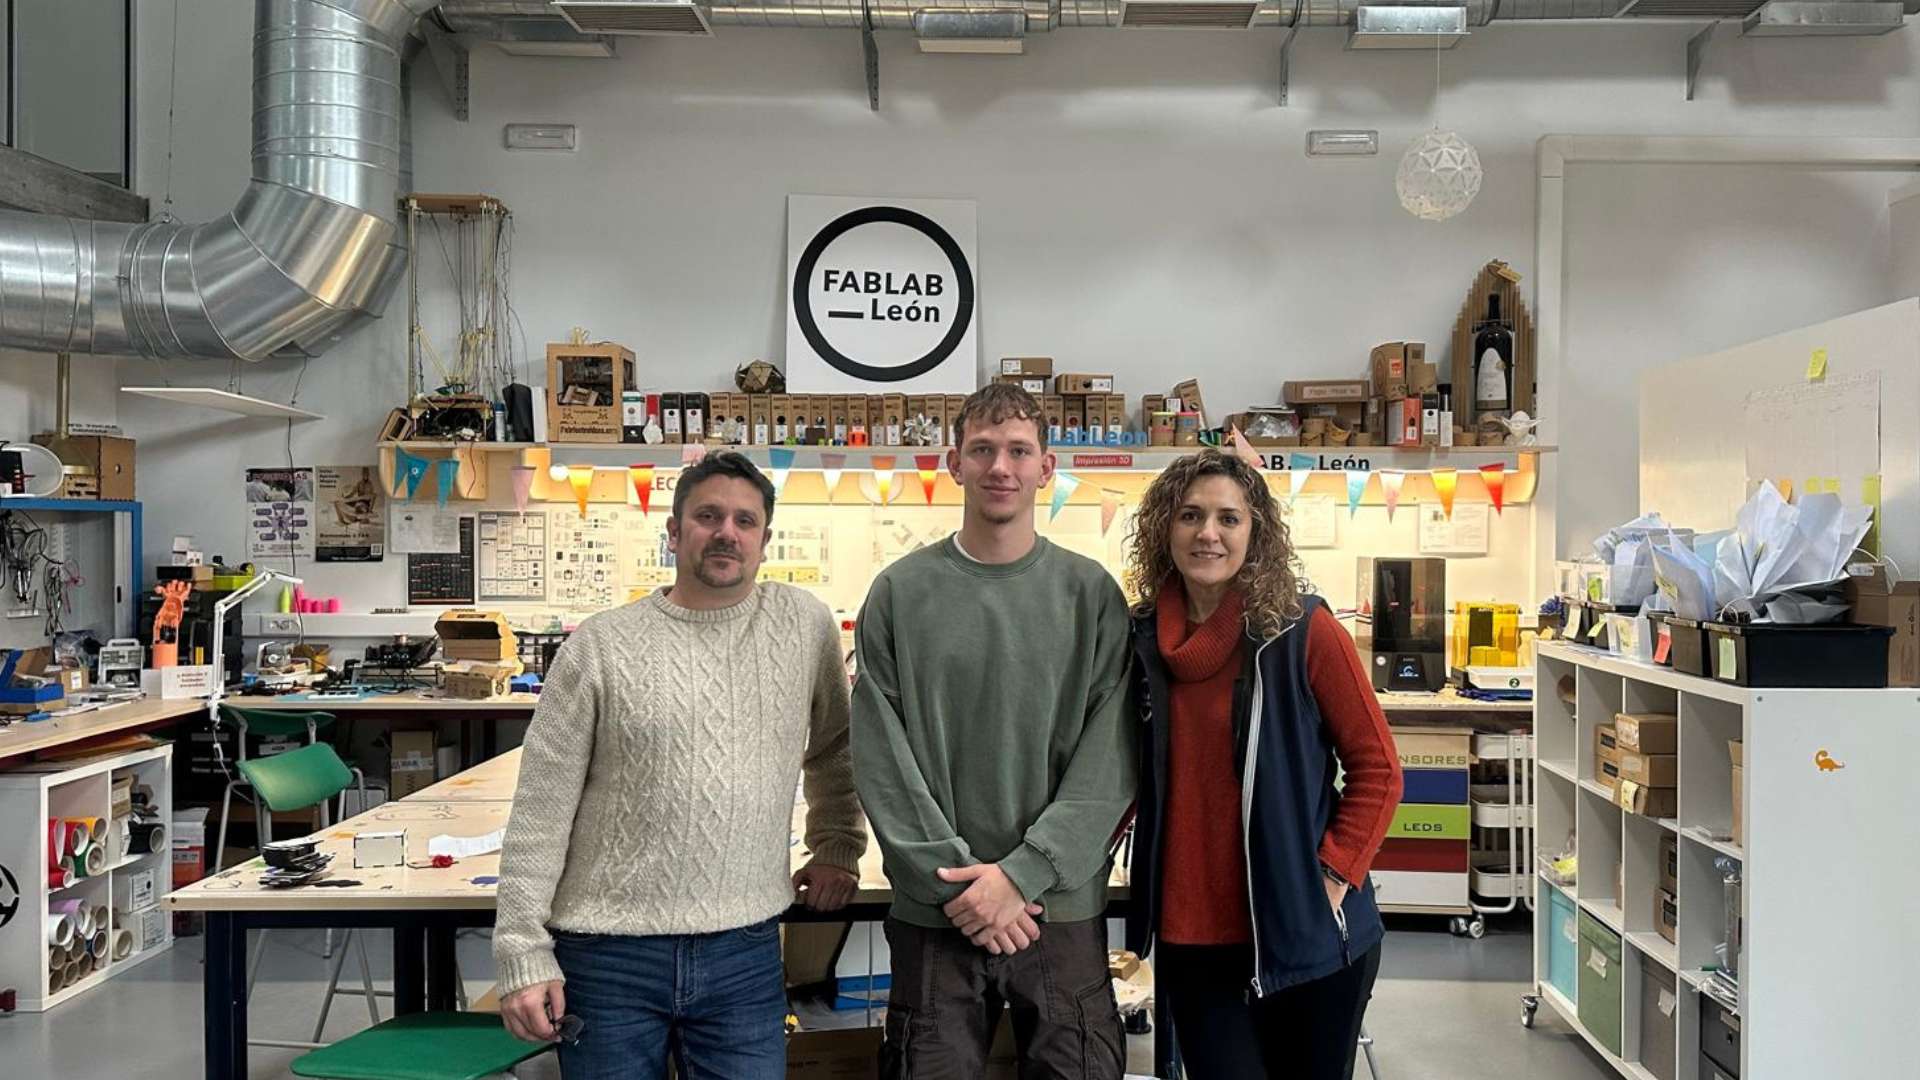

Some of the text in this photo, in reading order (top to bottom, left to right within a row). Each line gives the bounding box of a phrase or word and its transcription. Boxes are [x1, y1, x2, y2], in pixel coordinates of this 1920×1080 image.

[823, 269, 943, 297] FABLAB
[871, 298, 940, 323] León
[1319, 454, 1370, 471] León
[1404, 823, 1442, 832] LEDS
